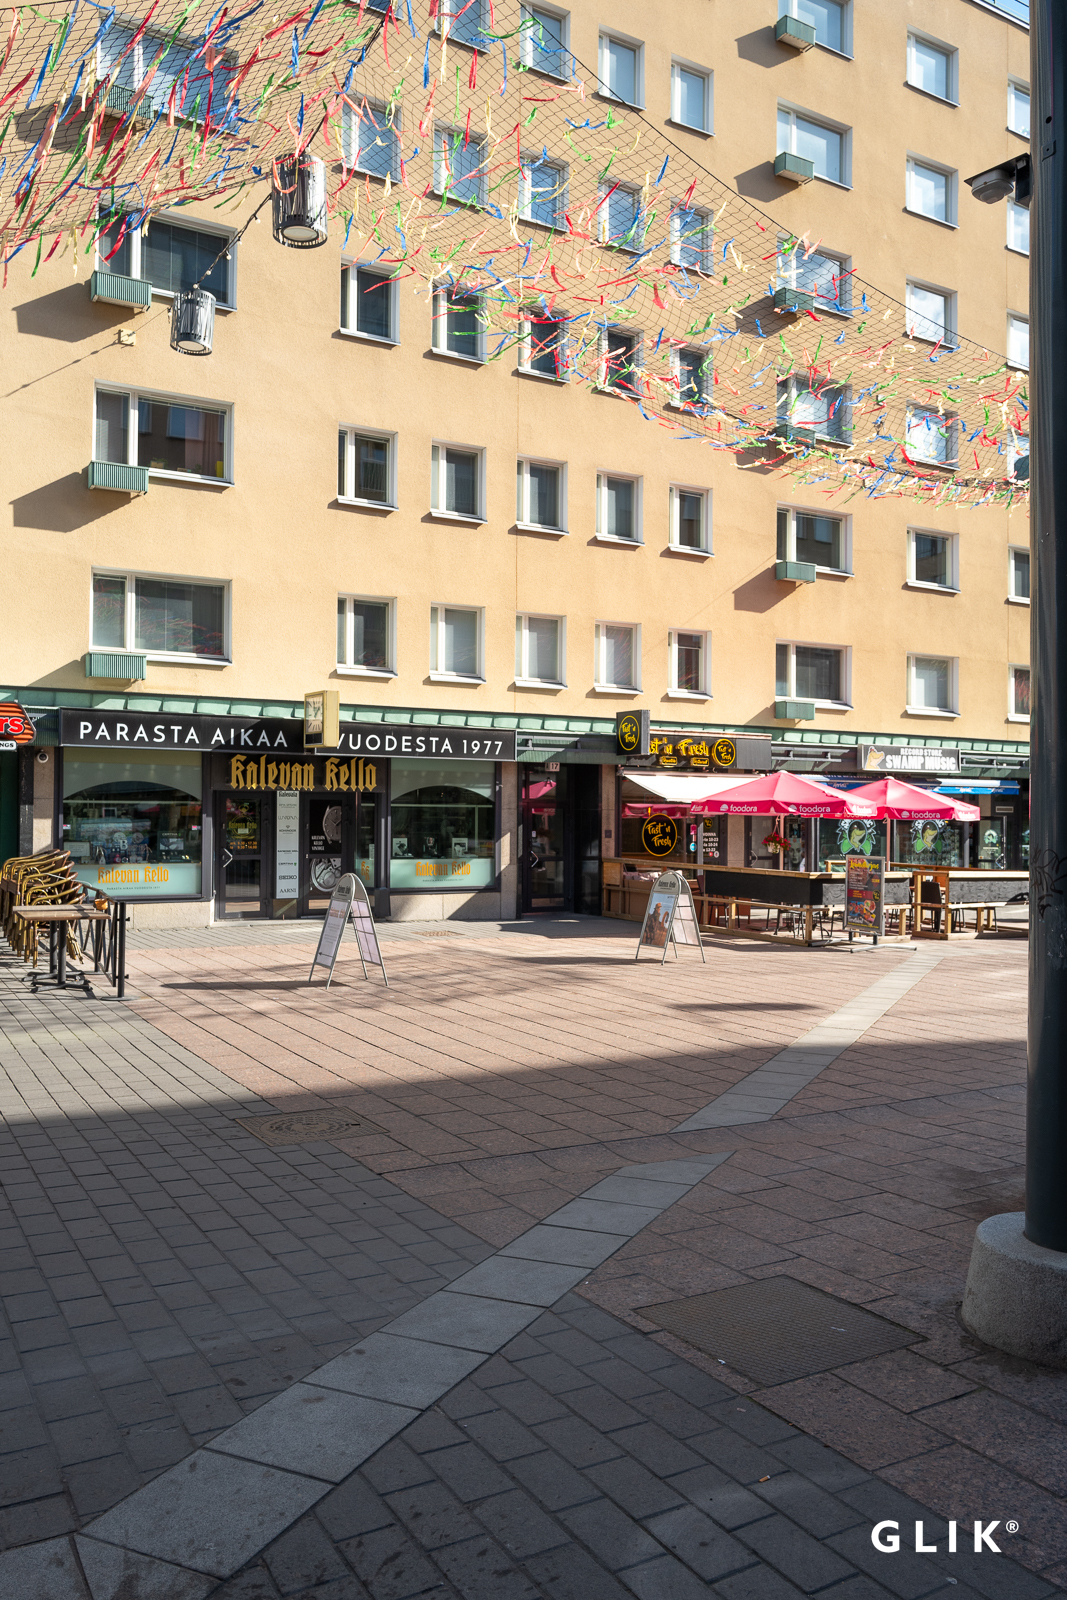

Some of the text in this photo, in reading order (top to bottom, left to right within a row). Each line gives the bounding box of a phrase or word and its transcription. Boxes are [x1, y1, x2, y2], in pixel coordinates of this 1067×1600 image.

[79, 721, 200, 744] PARASTA
[211, 727, 288, 747] AIKAA
[462, 740, 503, 755] 1977
[624, 732, 636, 743] Fresh
[676, 738, 709, 756] Fresh
[900, 748, 942, 757] RECORD STORE
[885, 755, 956, 771] SWAMP MUSIC
[230, 754, 377, 792] Kalevan Kello
[730, 803, 757, 812] foodora
[799, 804, 831, 813] foodora
[911, 810, 940, 819] foodora
[645, 821, 663, 835] Fast
[651, 833, 671, 847] Fresh
[97, 866, 169, 884] Kalevan Kello
[416, 861, 471, 877] Kalevan Kello
